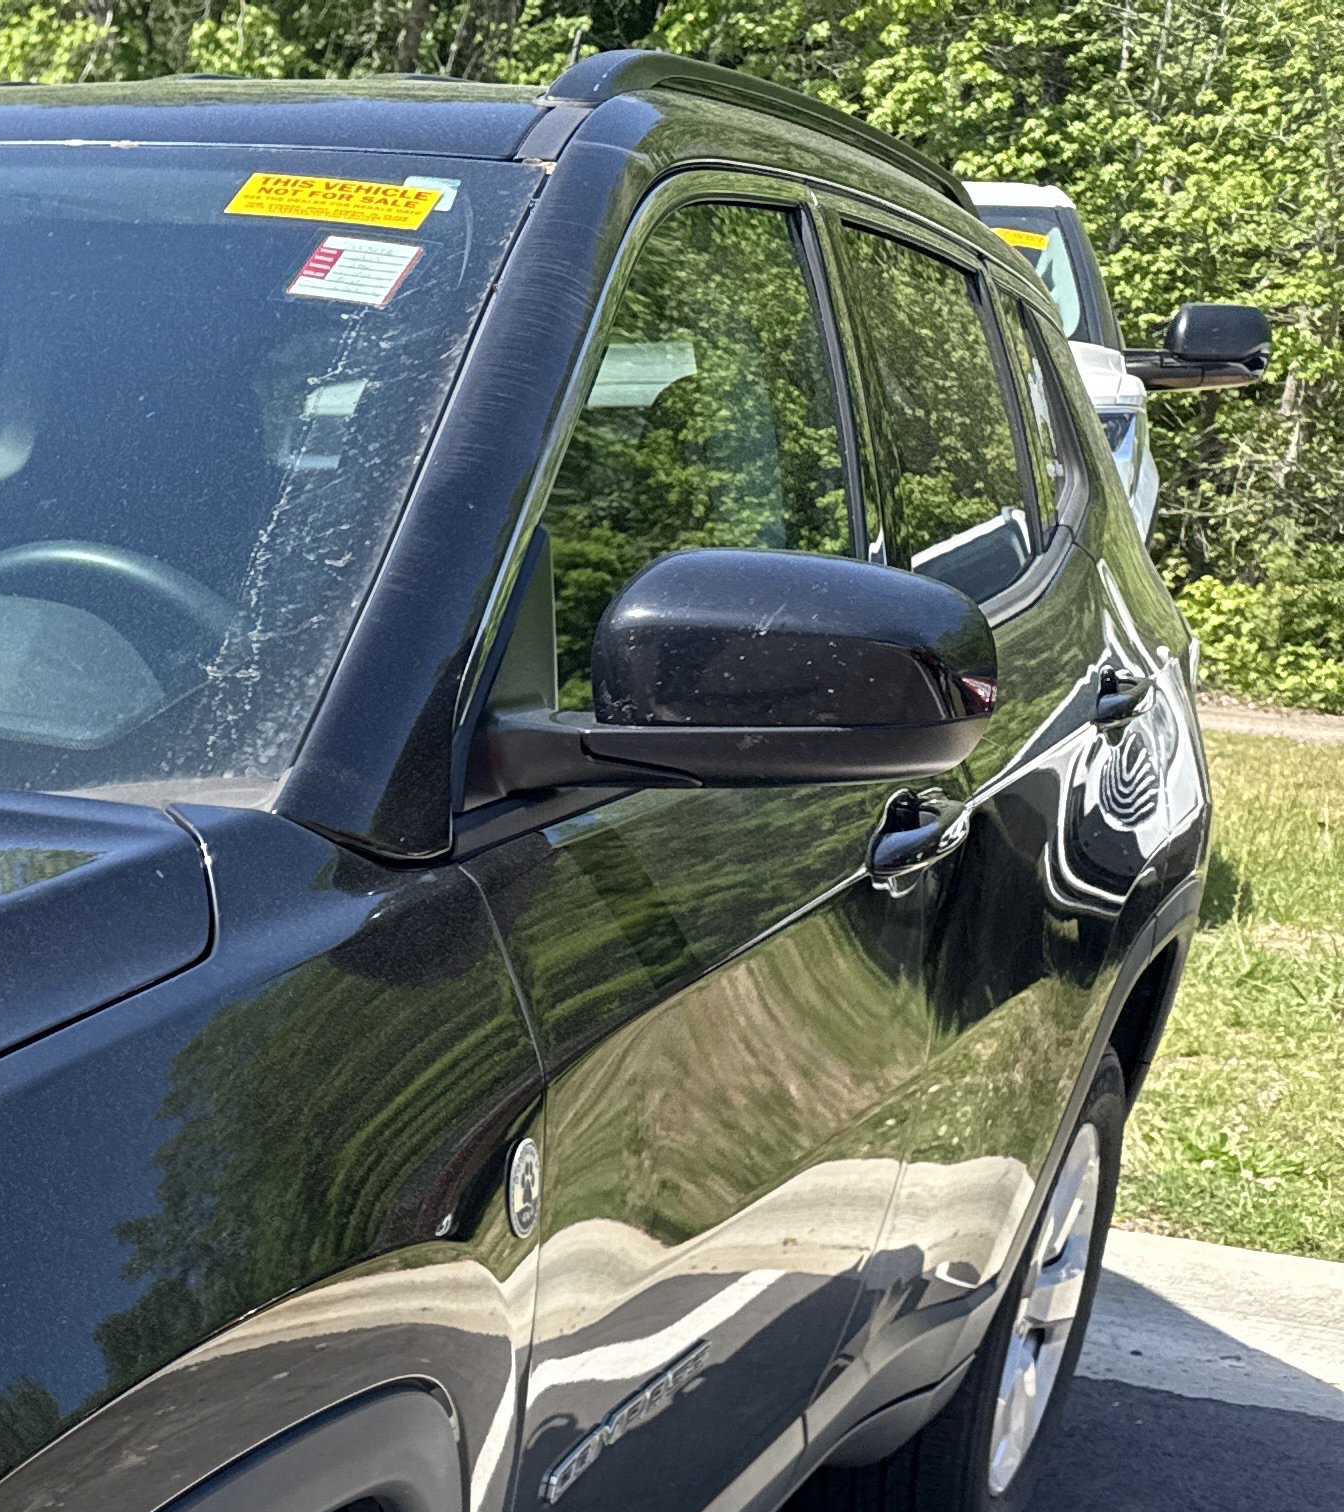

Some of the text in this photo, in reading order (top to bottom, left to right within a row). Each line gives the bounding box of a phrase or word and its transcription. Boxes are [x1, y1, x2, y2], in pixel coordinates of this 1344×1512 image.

[257, 187, 419, 209] NOT FOR SALE
[261, 176, 432, 201] THIS VEHICLE
